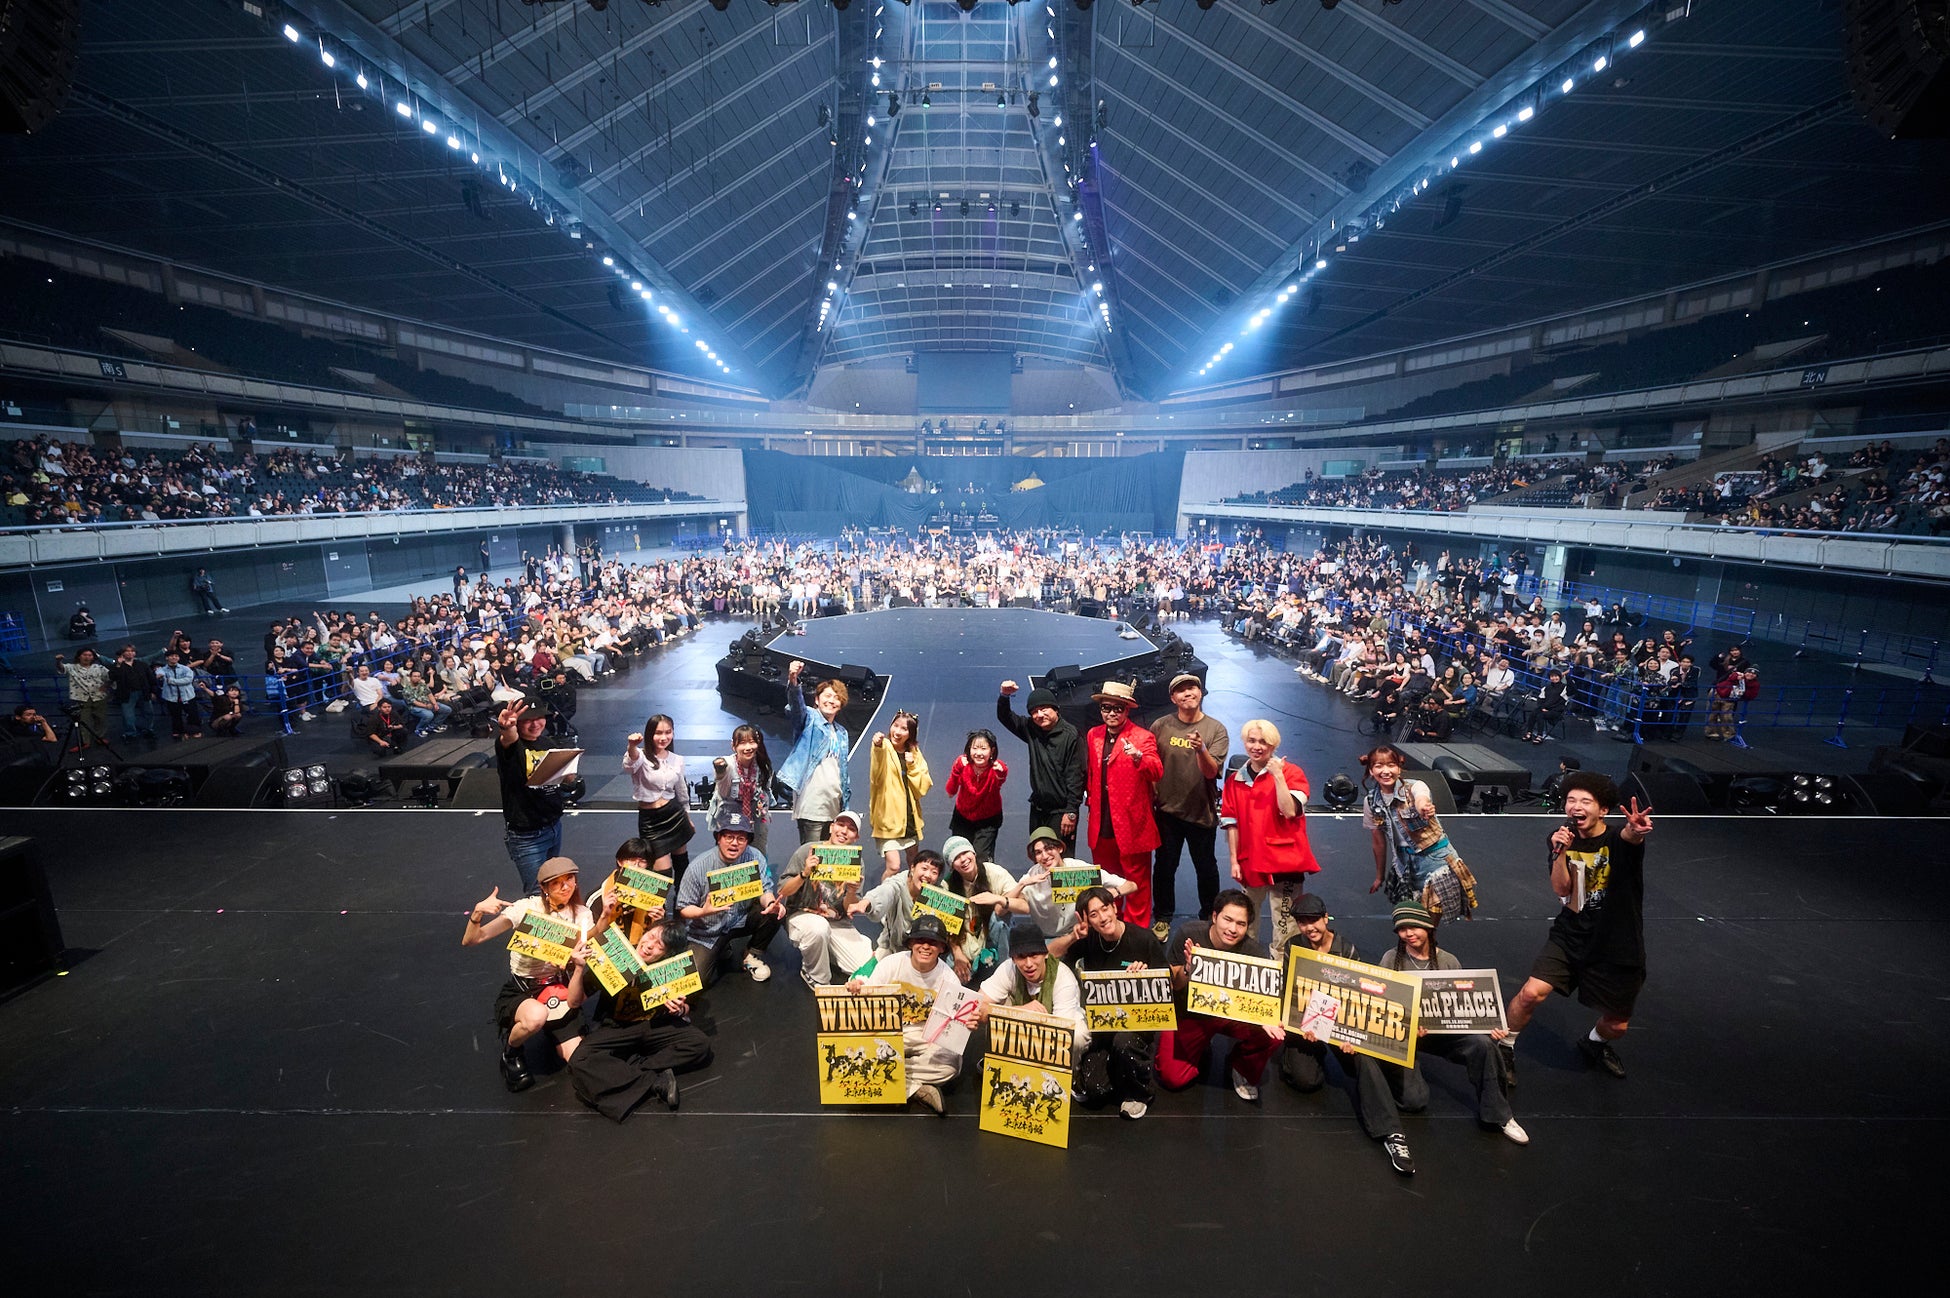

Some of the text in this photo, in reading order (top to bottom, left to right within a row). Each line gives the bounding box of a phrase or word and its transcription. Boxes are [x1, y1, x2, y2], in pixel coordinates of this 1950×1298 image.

[1084, 978, 1172, 1005] 2nd PLACE
[1190, 955, 1225, 986] 2nd
[1226, 961, 1280, 997] PLACE
[817, 996, 900, 1032] WINNER
[1419, 991, 1497, 1018] nd PLACE
[989, 1016, 1072, 1066] WINNER
